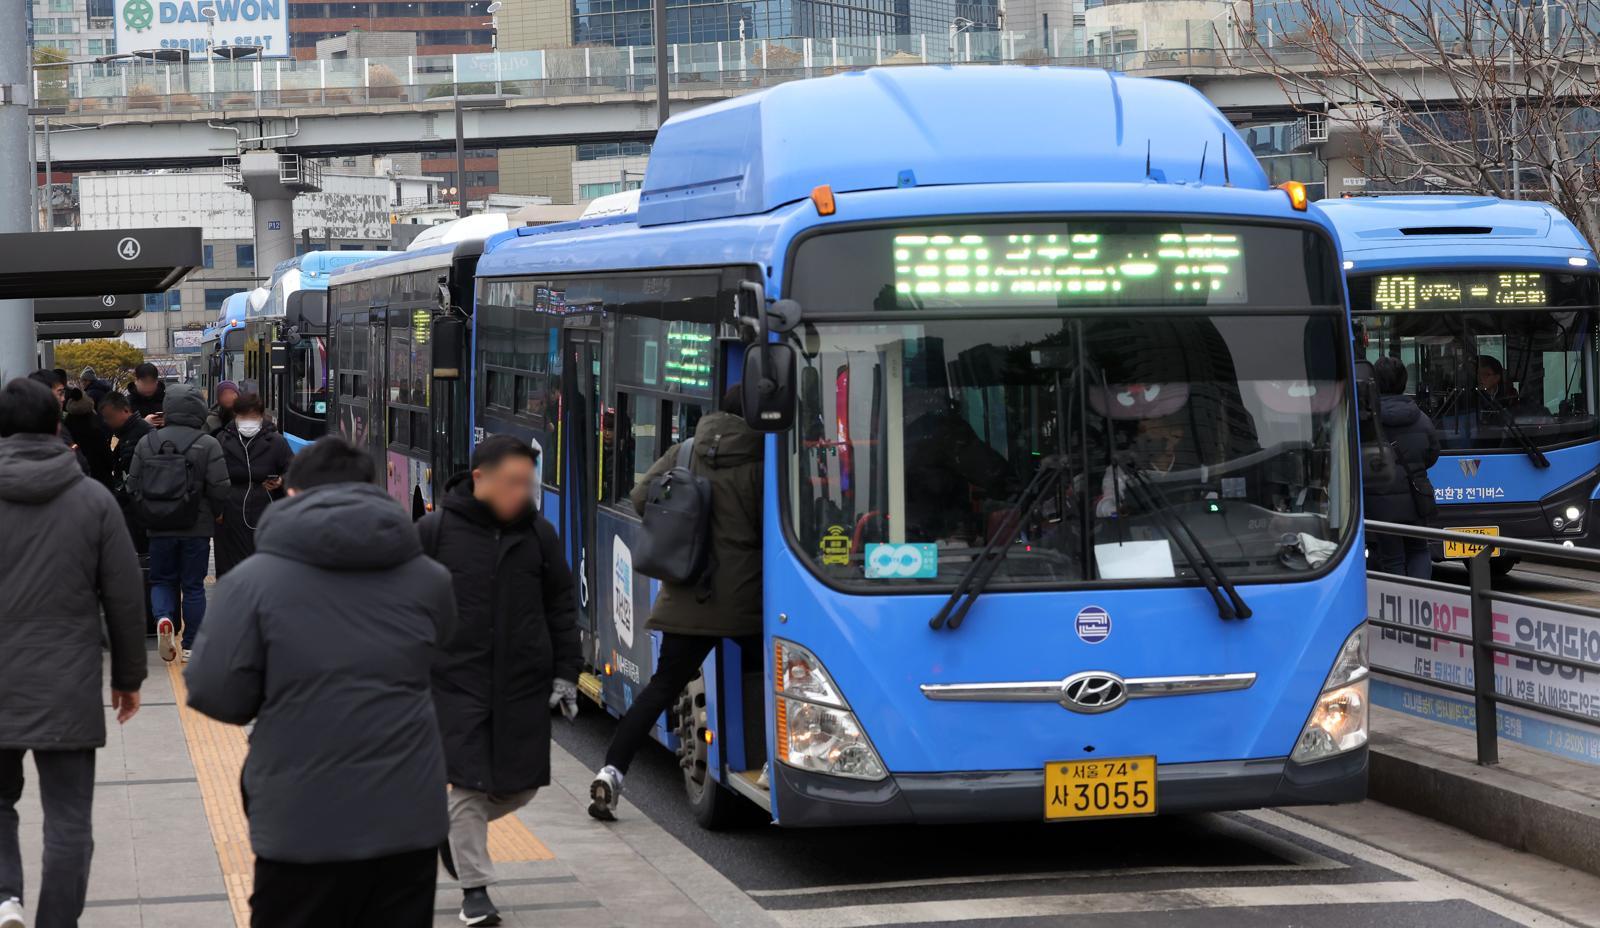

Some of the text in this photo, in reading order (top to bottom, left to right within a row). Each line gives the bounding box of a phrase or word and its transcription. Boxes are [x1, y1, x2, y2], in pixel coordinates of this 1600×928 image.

[159, 0, 280, 23] DAEWON
[160, 38, 212, 53] SPRIN
[1375, 277, 1415, 309] 401
[1434, 487, 1505, 500] 친환경 전기버스
[1072, 763, 1128, 779] 서울 74
[1051, 780, 1149, 812] 사3055
